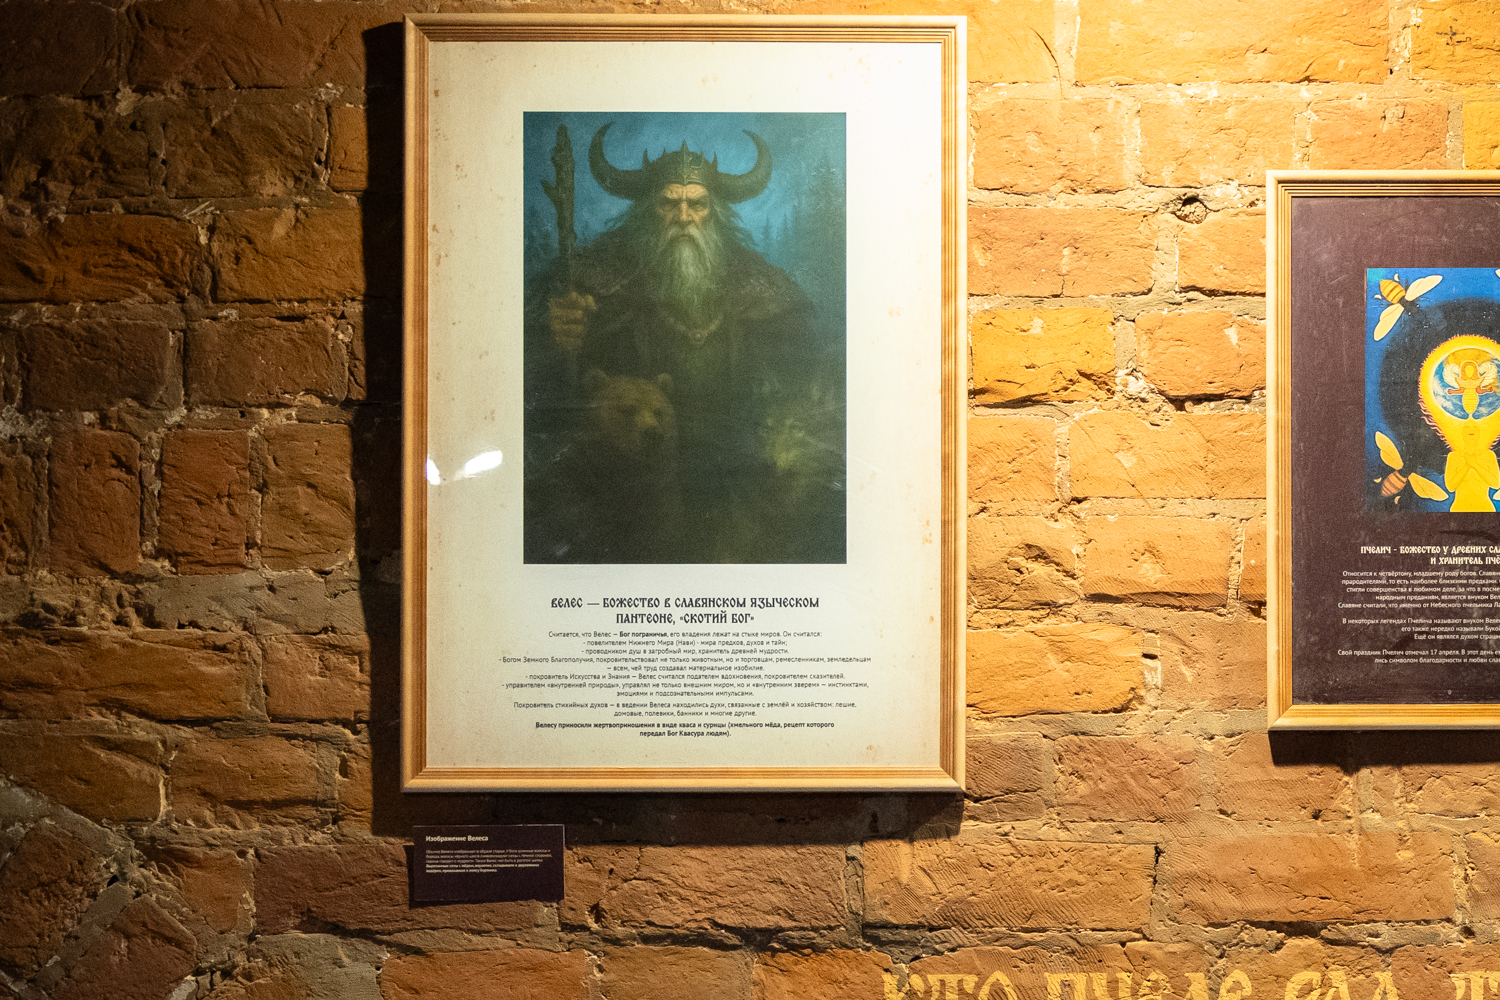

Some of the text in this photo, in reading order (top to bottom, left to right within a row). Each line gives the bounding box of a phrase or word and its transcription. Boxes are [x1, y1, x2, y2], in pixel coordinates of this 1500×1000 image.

[1360, 546, 1391, 554] ПЧЕЛИЧ
[1400, 546, 1440, 554] БОЖЕСТВО
[1443, 546, 1448, 554] У
[1451, 546, 1486, 555] ДРЕВНИХ
[550, 598, 583, 608] ВЕЛЕС
[602, 598, 660, 608] БОЖЕСТВО
[664, 598, 671, 608] В
[674, 598, 746, 608] СЛАВЯНСКОМ
[750, 598, 819, 609] ЯЗЫЧЕСКОМ
[616, 610, 754, 625] ПАНТЕОНЕ, «СКОТИЙ БОГ»
[648, 647, 682, 655] загробный
[731, 647, 757, 655] древней
[705, 729, 732, 737] людям).
